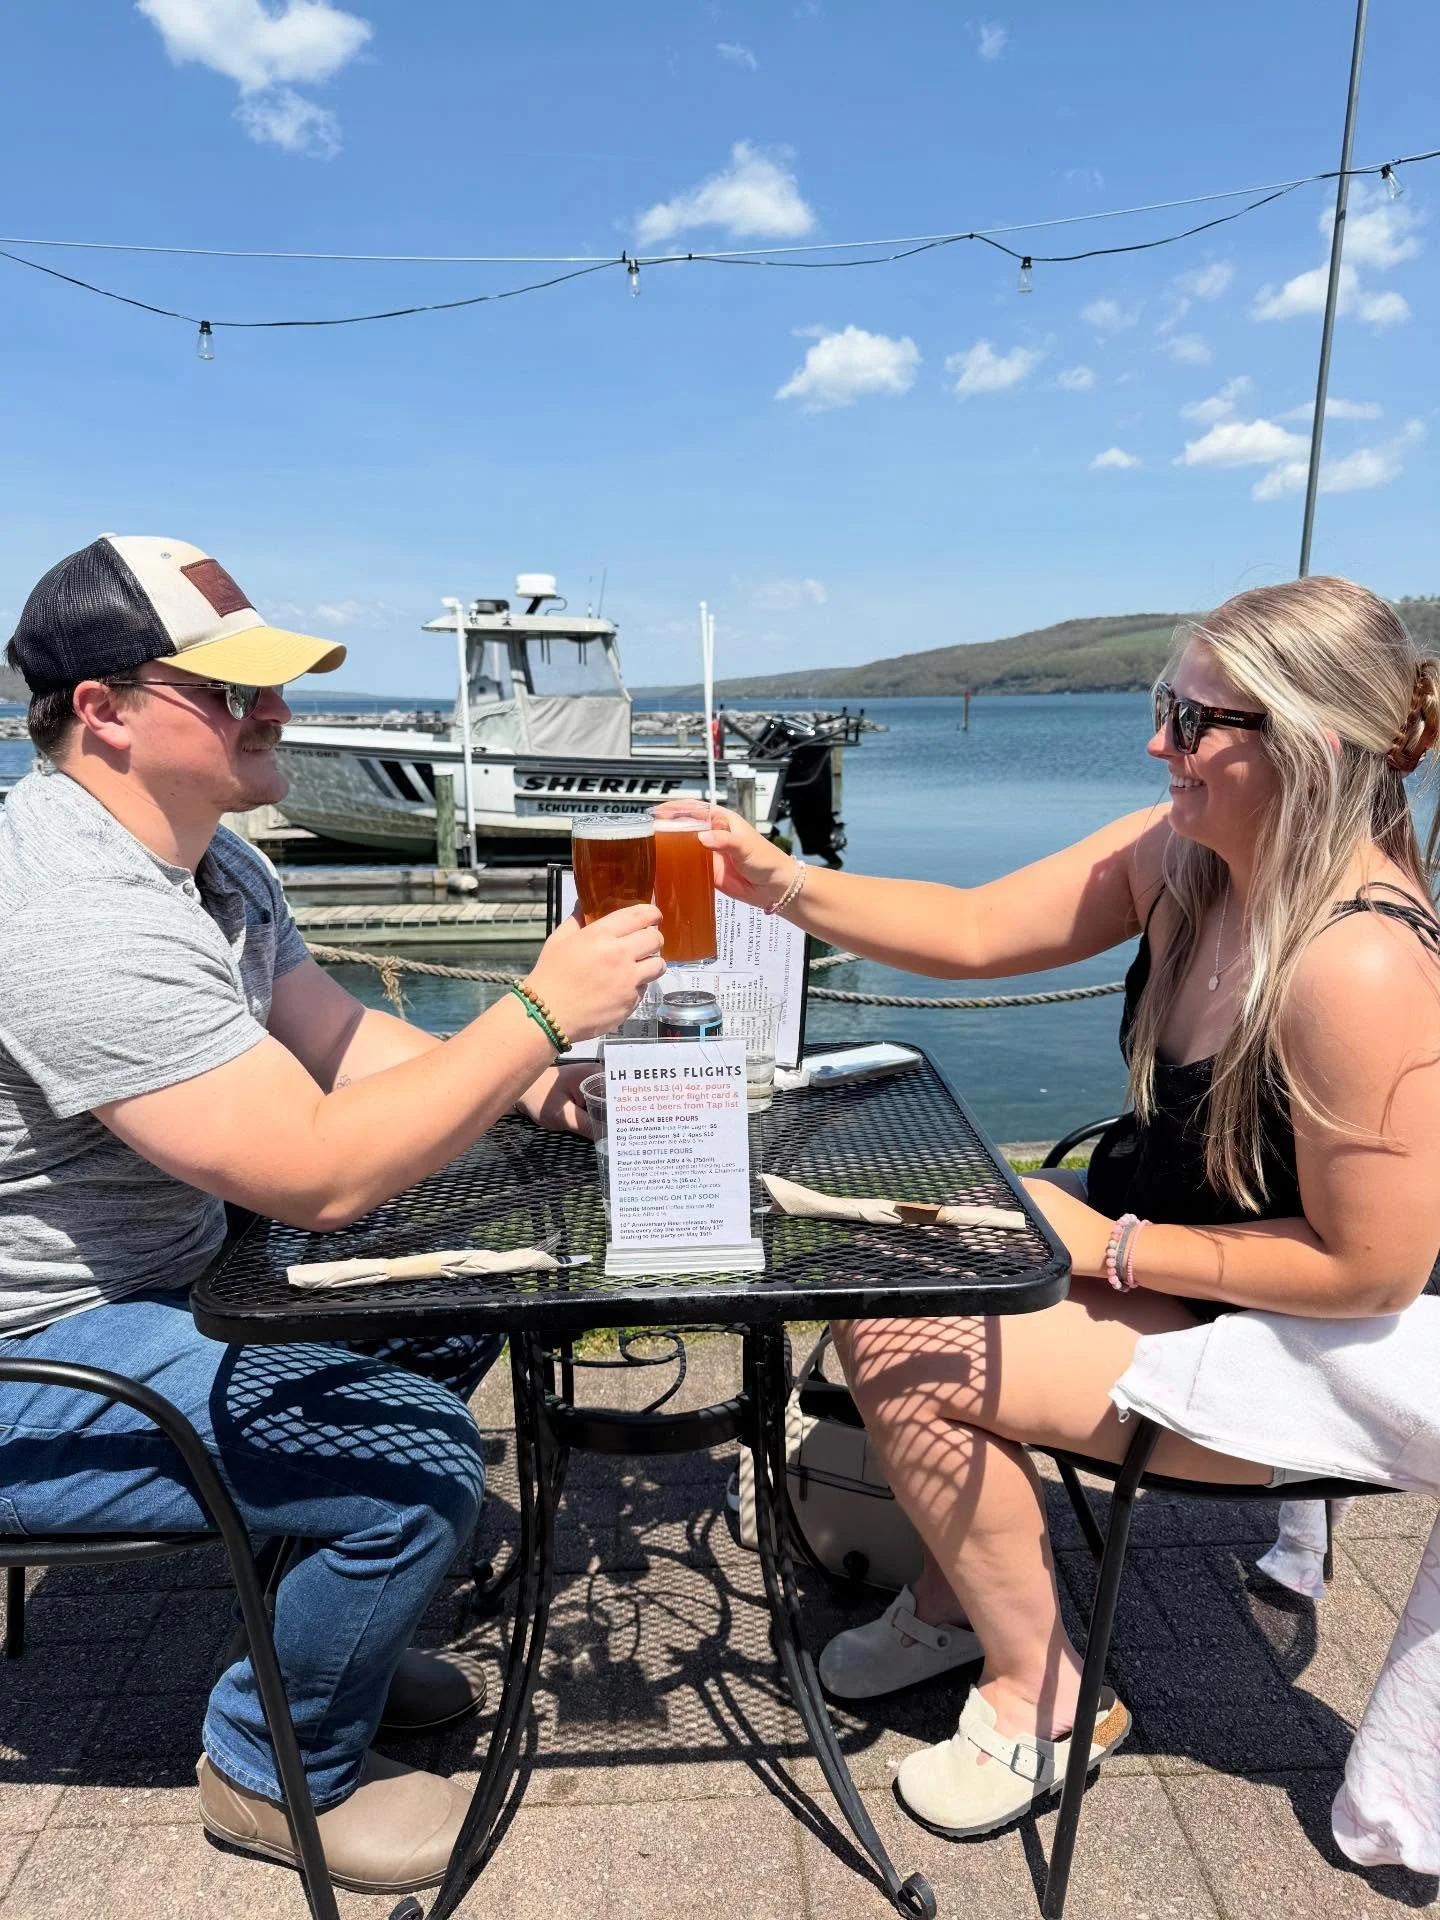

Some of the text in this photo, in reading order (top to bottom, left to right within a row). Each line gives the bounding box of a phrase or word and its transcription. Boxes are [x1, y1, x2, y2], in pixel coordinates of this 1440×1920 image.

[523, 775, 683, 795] SHERIFF
[537, 802, 647, 814] SCHUYLER COUNT
[610, 1065, 742, 1081] LH BEERS FLIGHTS
[621, 1083, 731, 1094] Flights $13 (4) 4oz. pours
[672, 1093, 685, 1101] for
[686, 1092, 710, 1102] flight
[711, 1091, 730, 1099] card
[615, 1103, 647, 1112] choose
[657, 1102, 682, 1111] beers
[684, 1101, 704, 1110] from
[706, 1101, 723, 1111] Tap
[725, 1100, 739, 1108] list
[617, 1149, 641, 1157] SINGLE
[642, 1148, 668, 1156] BOTTLE
